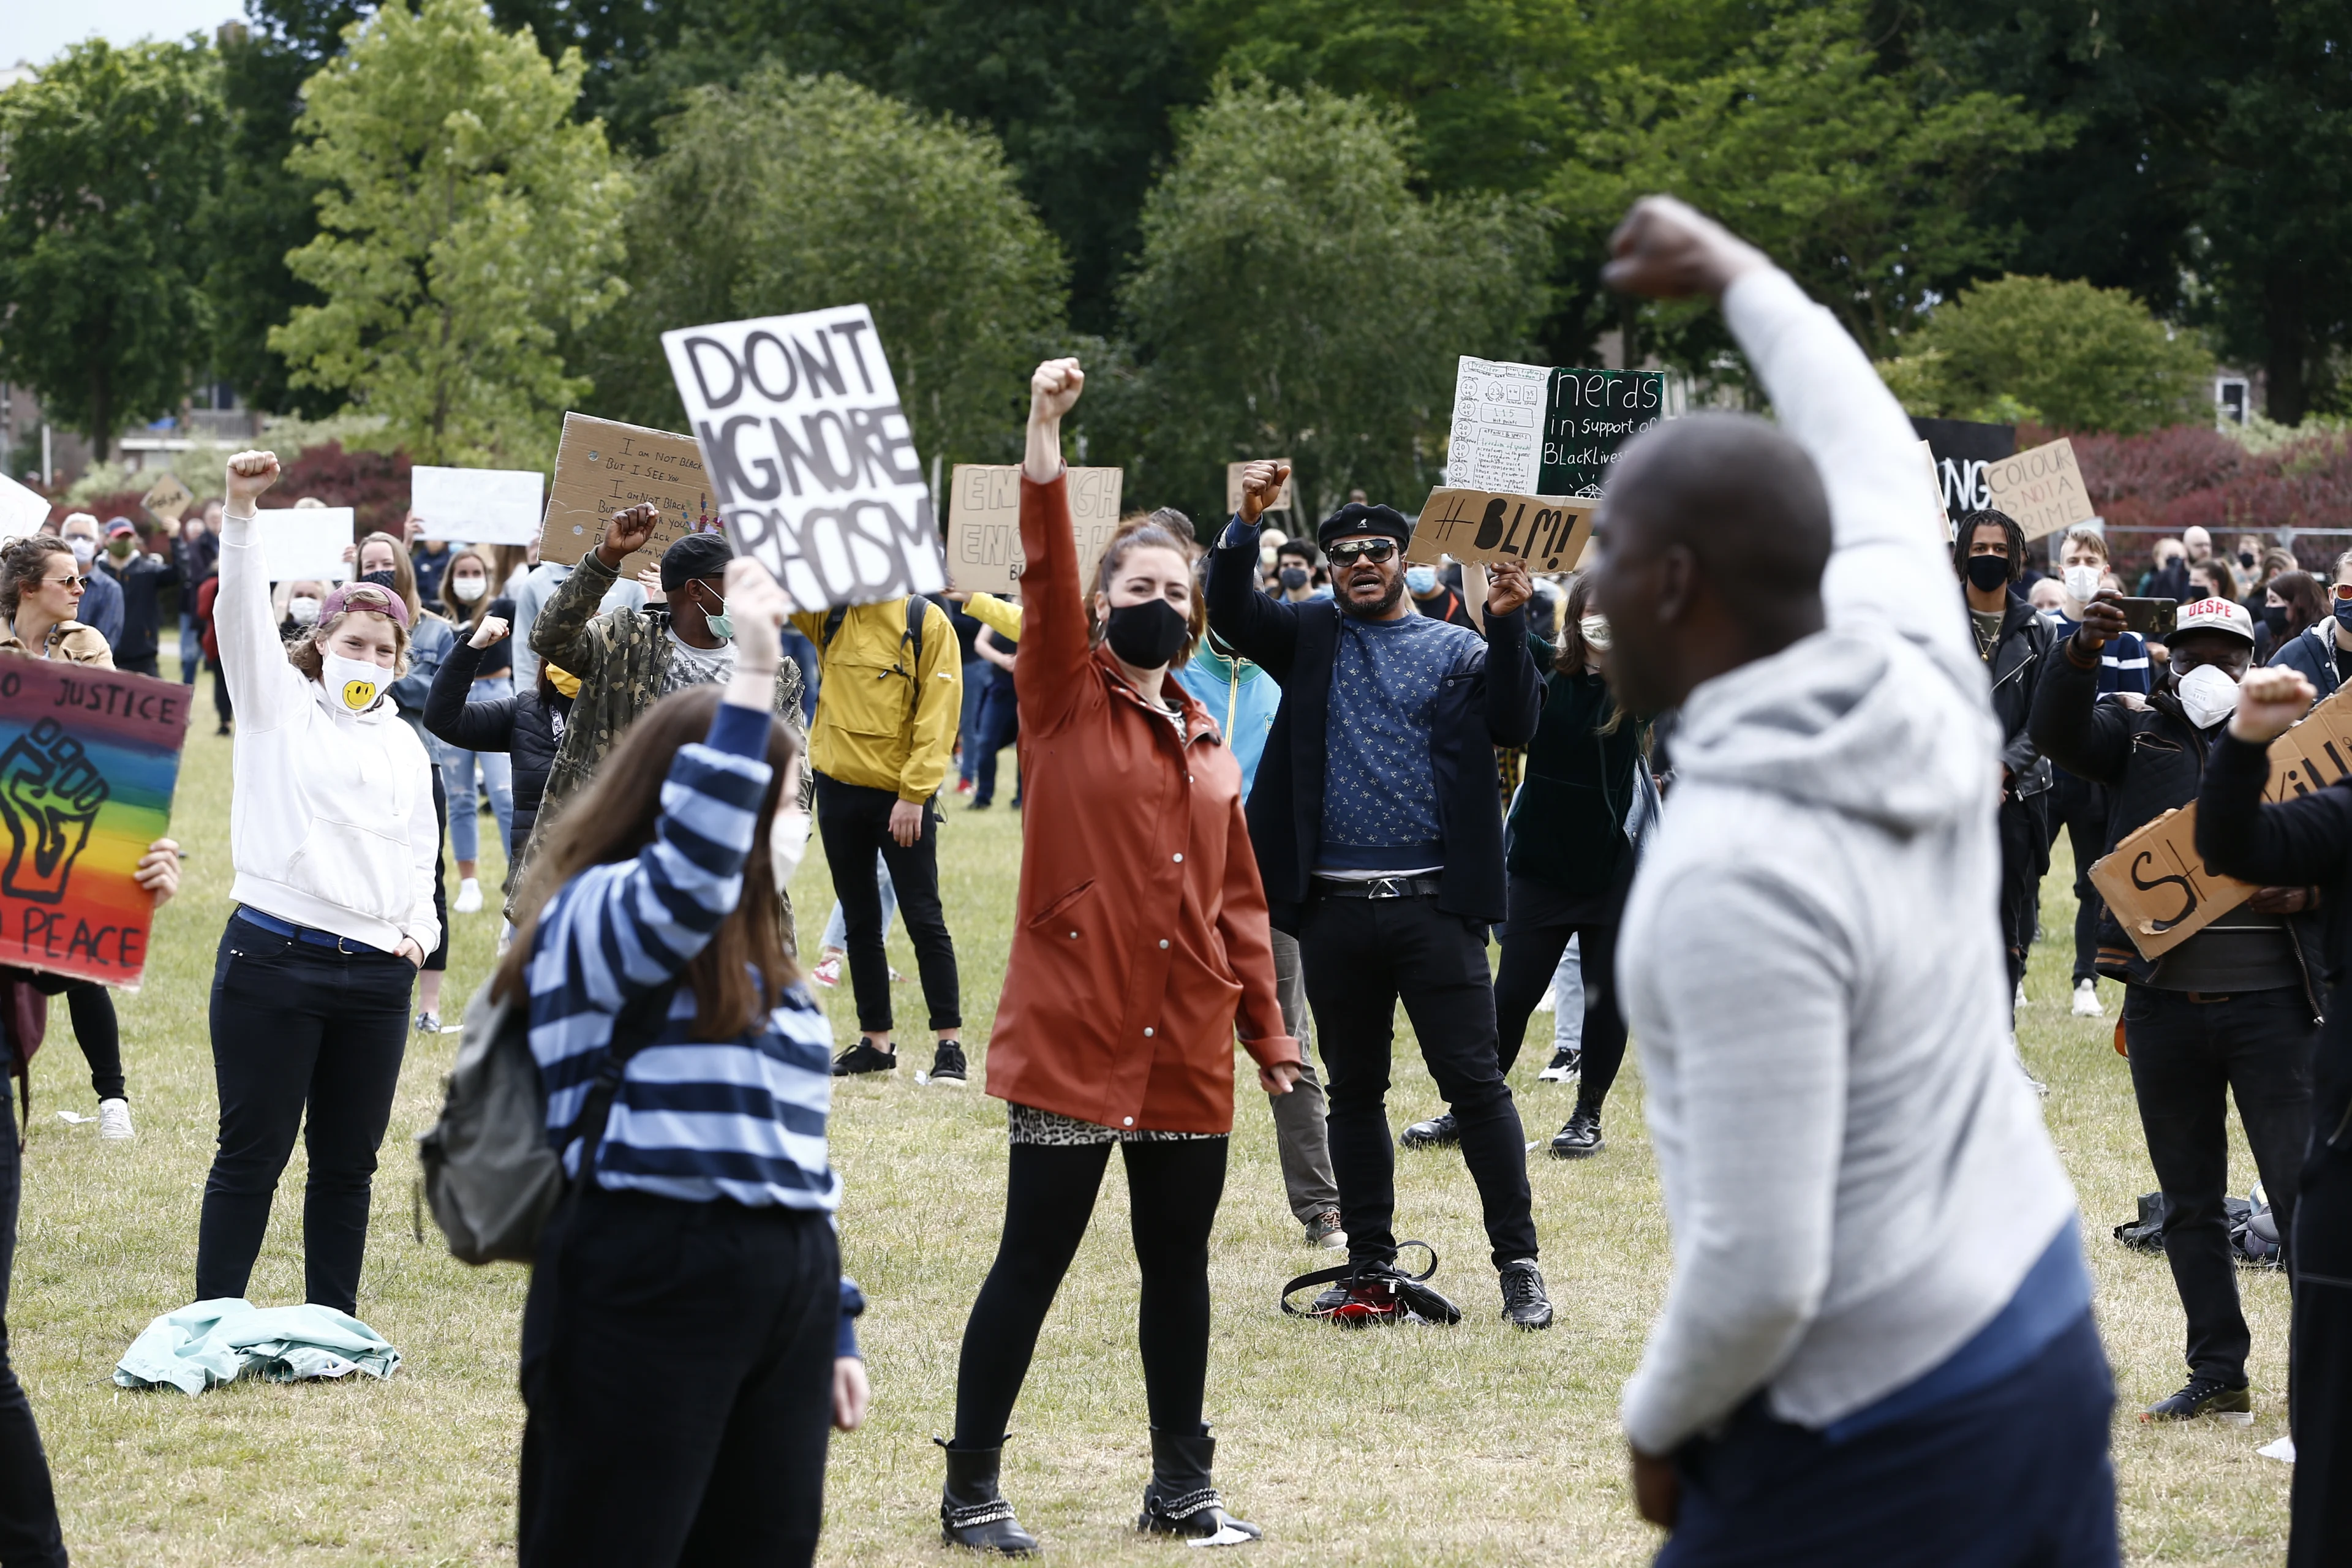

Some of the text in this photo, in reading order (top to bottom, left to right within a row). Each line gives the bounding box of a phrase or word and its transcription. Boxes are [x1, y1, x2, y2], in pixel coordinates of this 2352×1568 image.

[684, 320, 875, 409] DONT
[1556, 371, 1658, 409] nerds
[1494, 407, 1515, 417] 115
[1551, 414, 1575, 438] in
[619, 437, 635, 456] I
[655, 452, 677, 464] NOT
[679, 457, 703, 470] BLACK
[630, 465, 640, 475] I
[645, 467, 665, 481] SEE
[699, 404, 926, 506] IGNORE
[1988, 442, 2073, 495] COLOUR
[608, 479, 624, 499] I
[639, 492, 661, 504] NOT
[963, 468, 1121, 518] ENGH
[1998, 475, 2075, 513] IS NOT A
[597, 518, 609, 530] I
[2022, 497, 2082, 537] RIME
[729, 496, 948, 612] RACISM
[1, 672, 178, 725] O JUSTICE
[23, 907, 142, 967] PEACE
